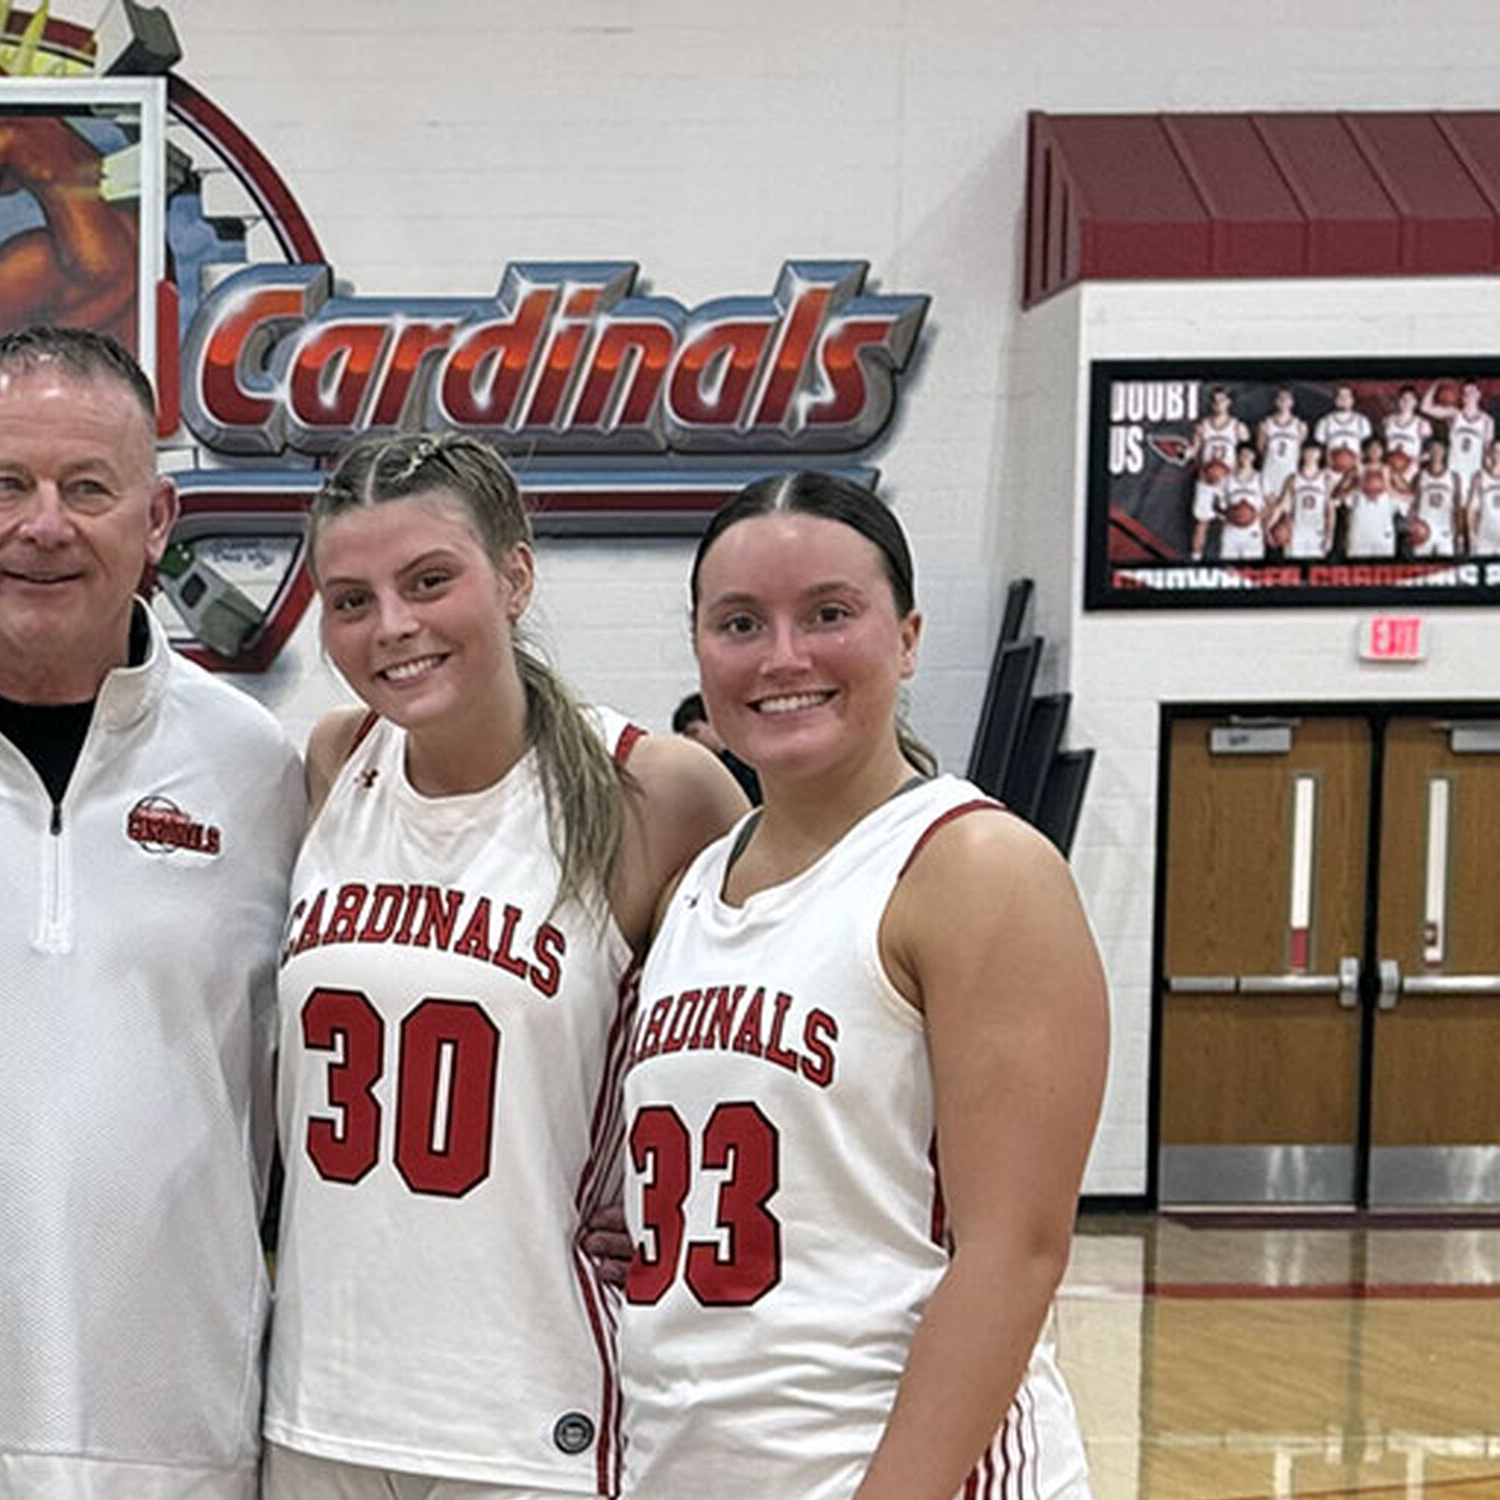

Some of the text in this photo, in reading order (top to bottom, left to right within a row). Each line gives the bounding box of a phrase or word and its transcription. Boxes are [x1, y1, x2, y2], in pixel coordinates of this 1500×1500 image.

[182, 258, 932, 458] Cardinals
[1109, 425, 1144, 474] US
[1371, 616, 1421, 657] EXIT
[301, 987, 500, 1198] 30
[631, 984, 838, 1088] RDINALS
[625, 1101, 782, 1307] 33
